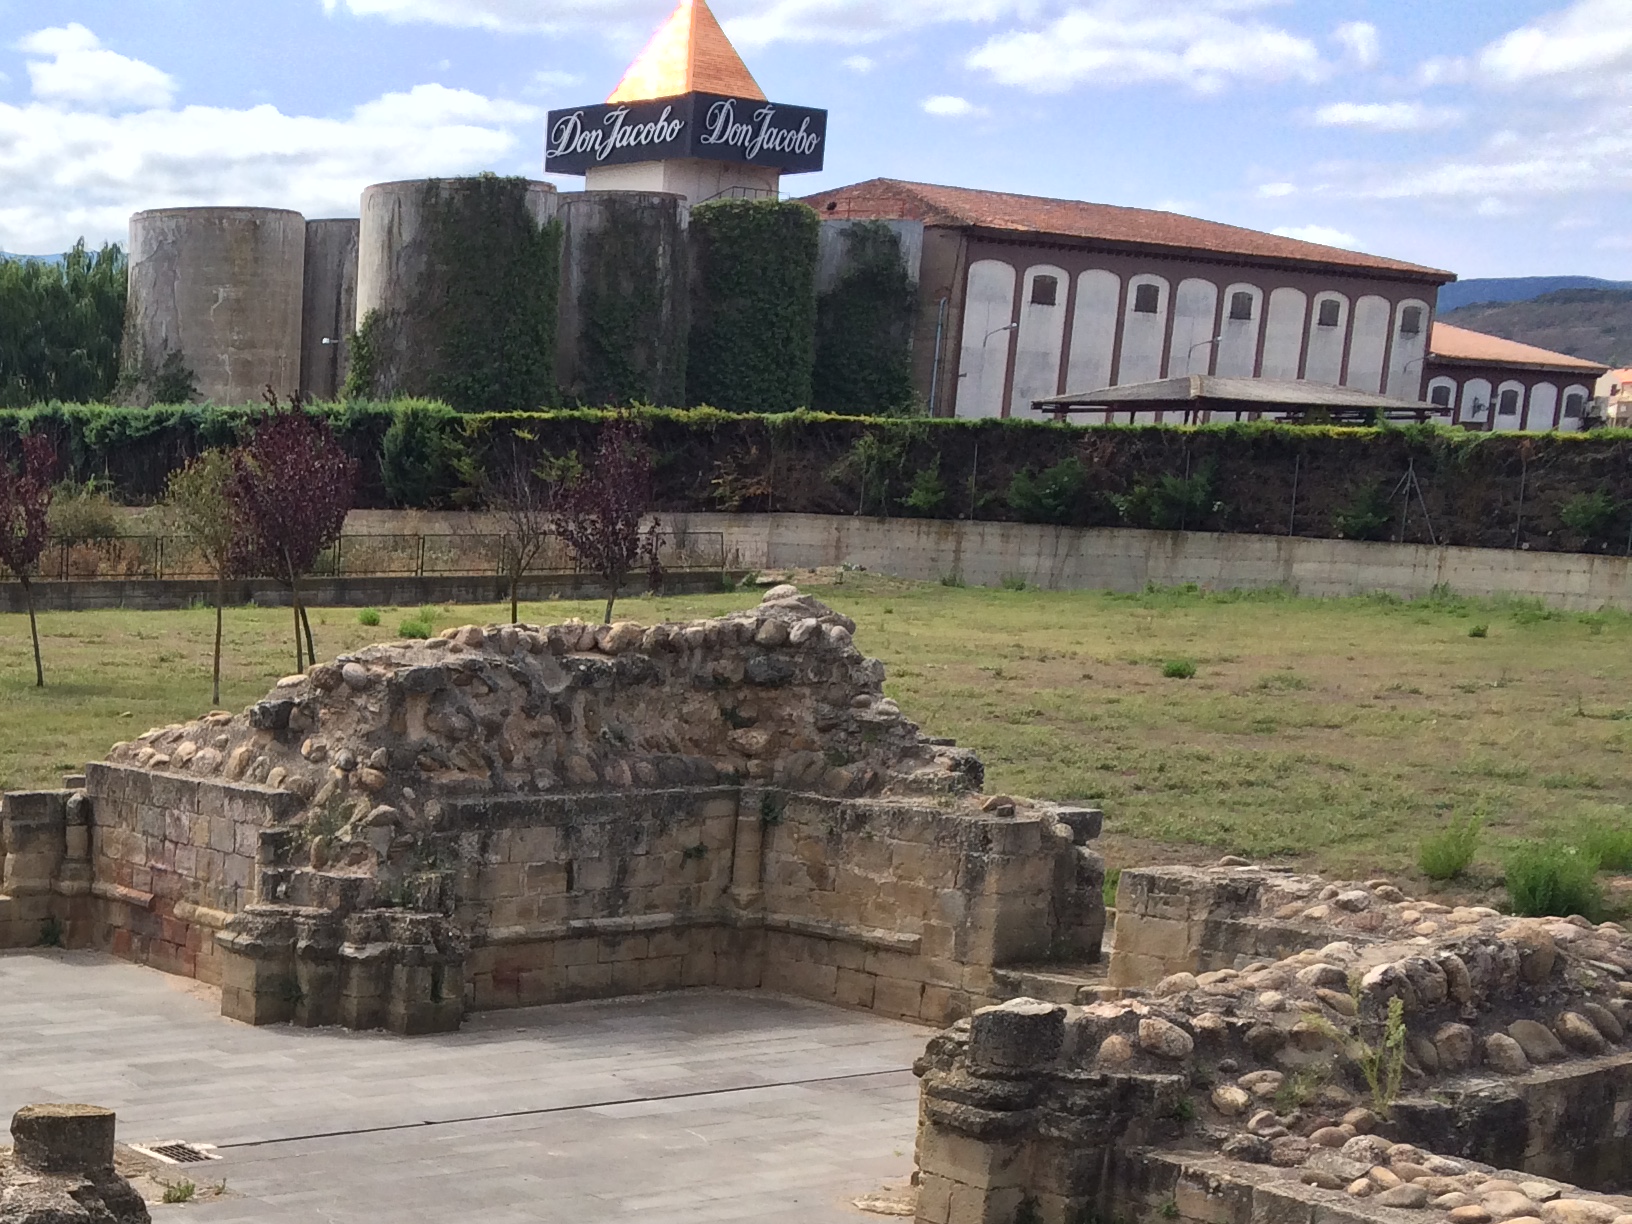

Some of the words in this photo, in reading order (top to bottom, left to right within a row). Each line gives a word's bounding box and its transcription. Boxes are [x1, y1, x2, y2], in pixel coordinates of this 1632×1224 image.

[546, 110, 602, 158] Don
[596, 105, 684, 161] Jacobo
[700, 98, 752, 147] Don
[746, 105, 820, 159] Jacobo
